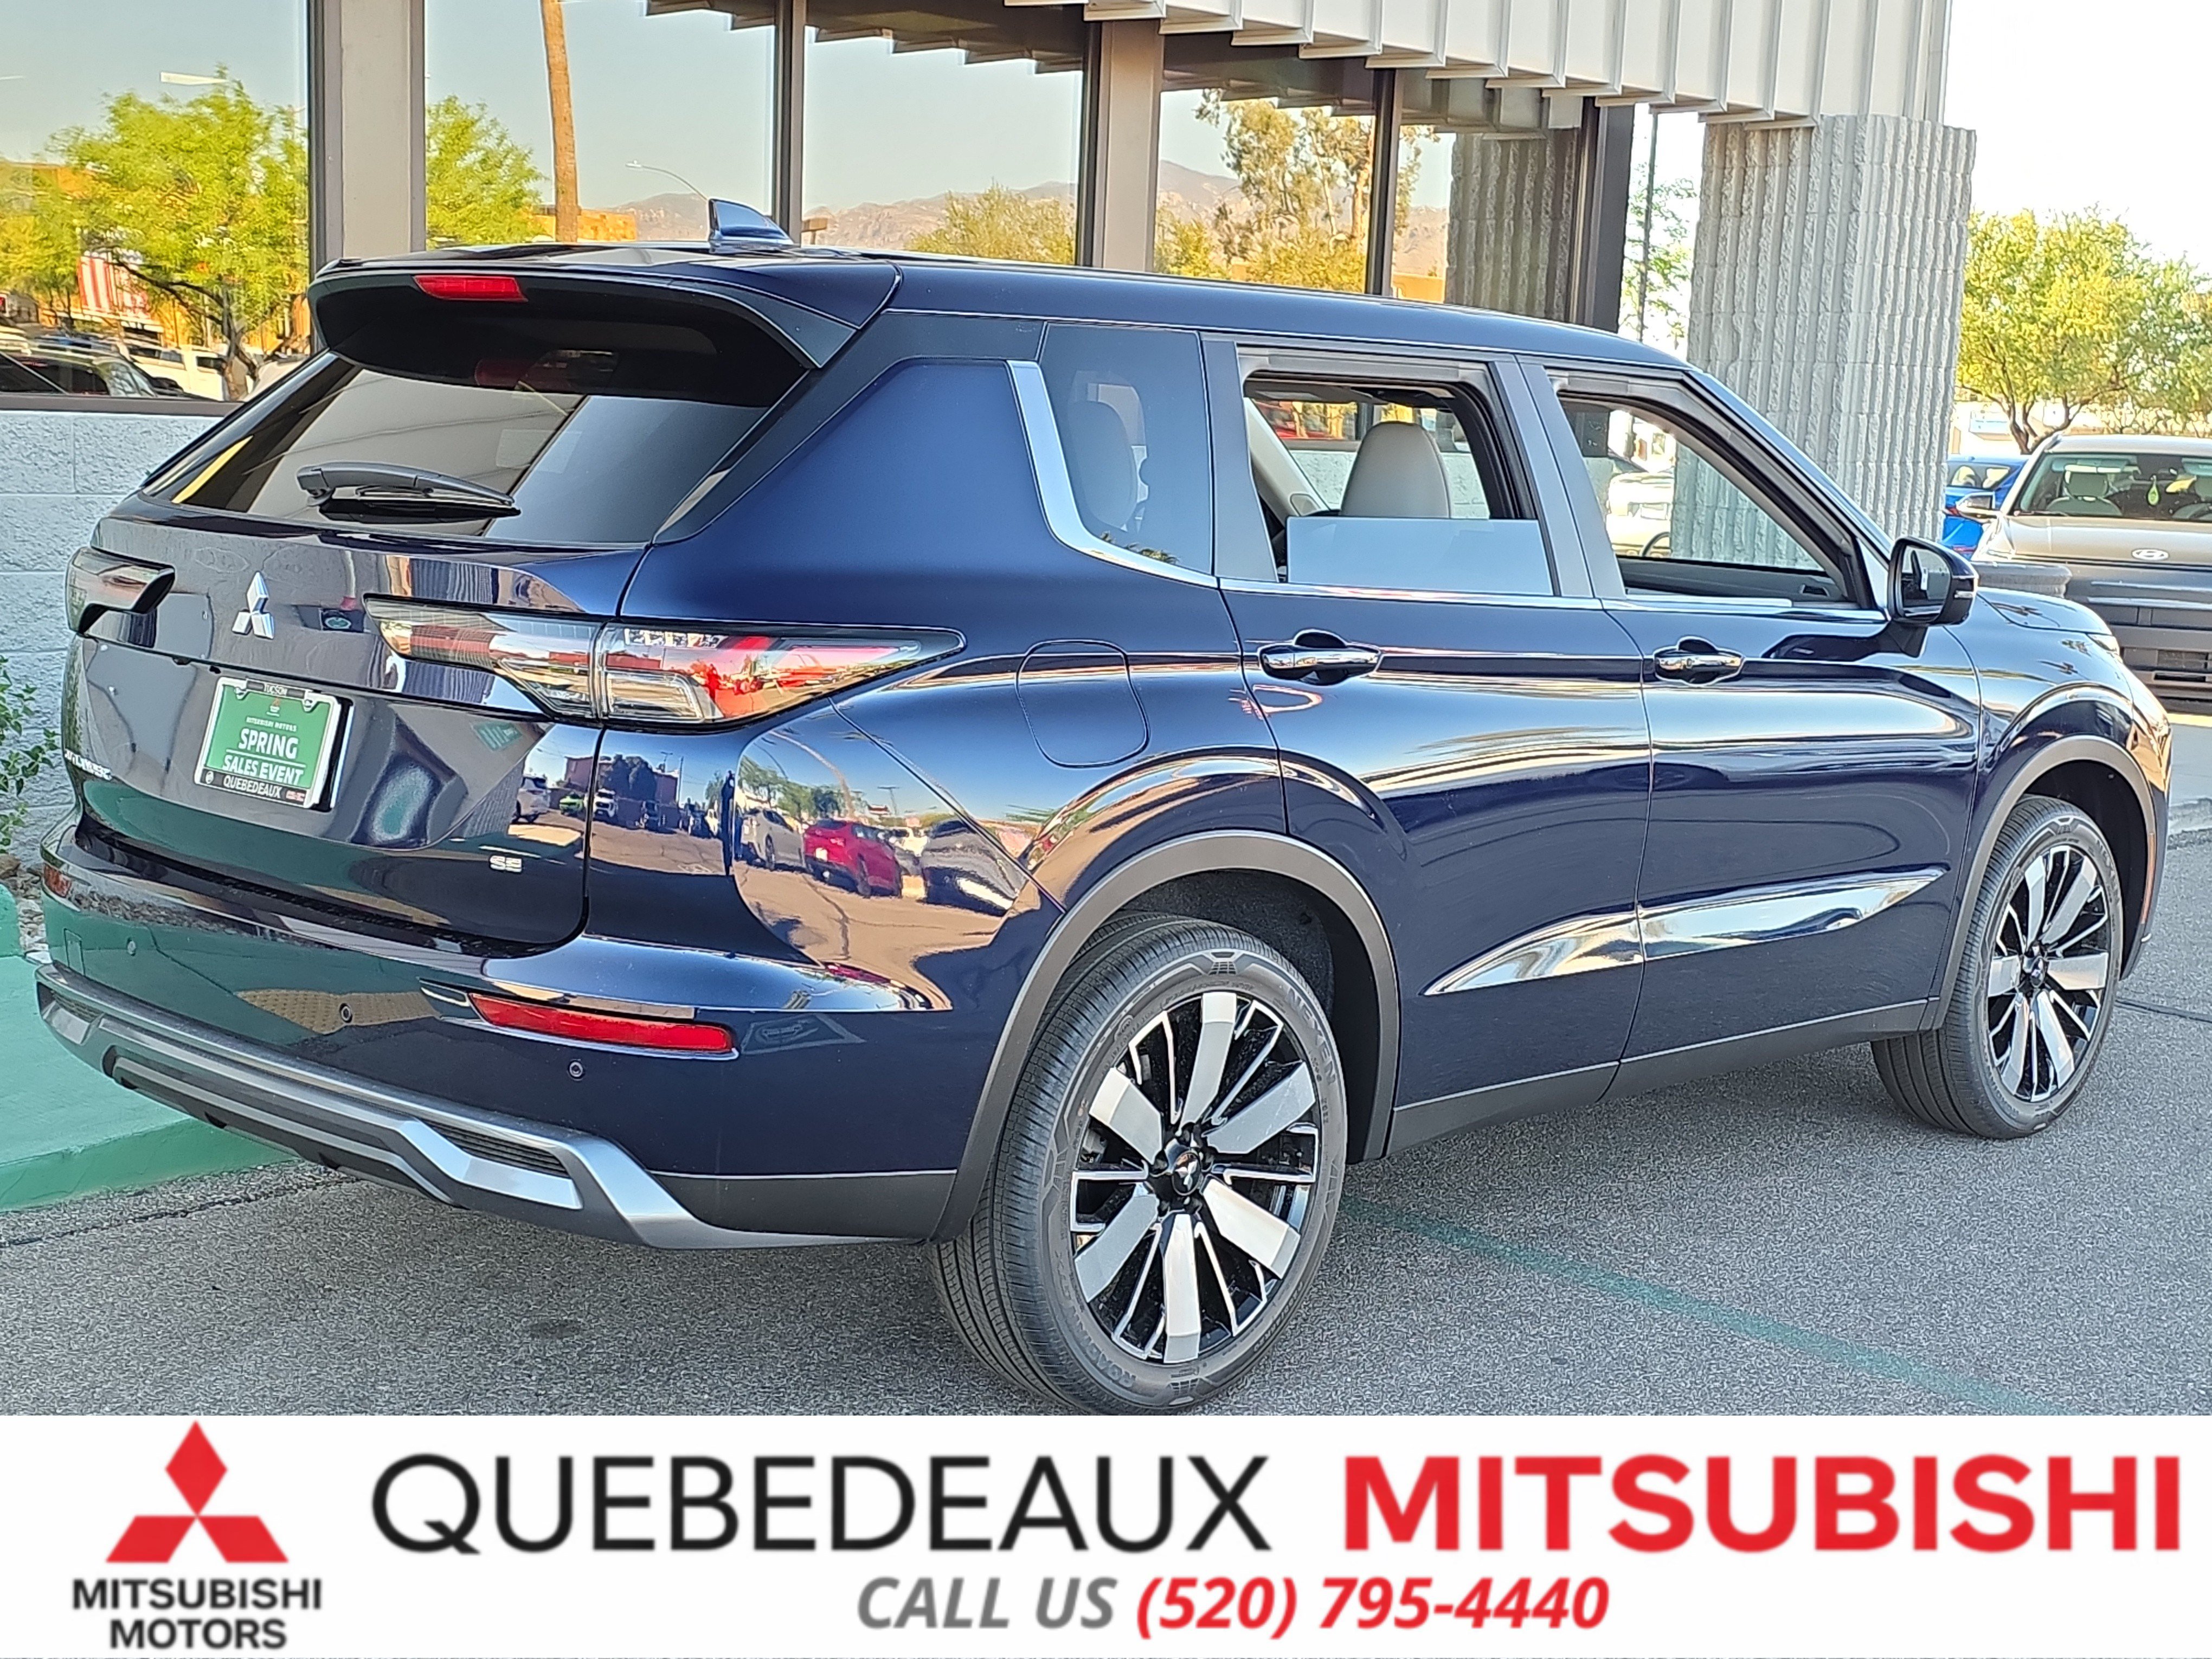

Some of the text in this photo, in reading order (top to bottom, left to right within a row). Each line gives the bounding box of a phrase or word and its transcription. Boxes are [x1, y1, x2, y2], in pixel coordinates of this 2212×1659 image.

[238, 728, 299, 759] SPRING
[222, 754, 304, 786] SALES EVENT
[223, 775, 283, 799] QUEBEDEAUX
